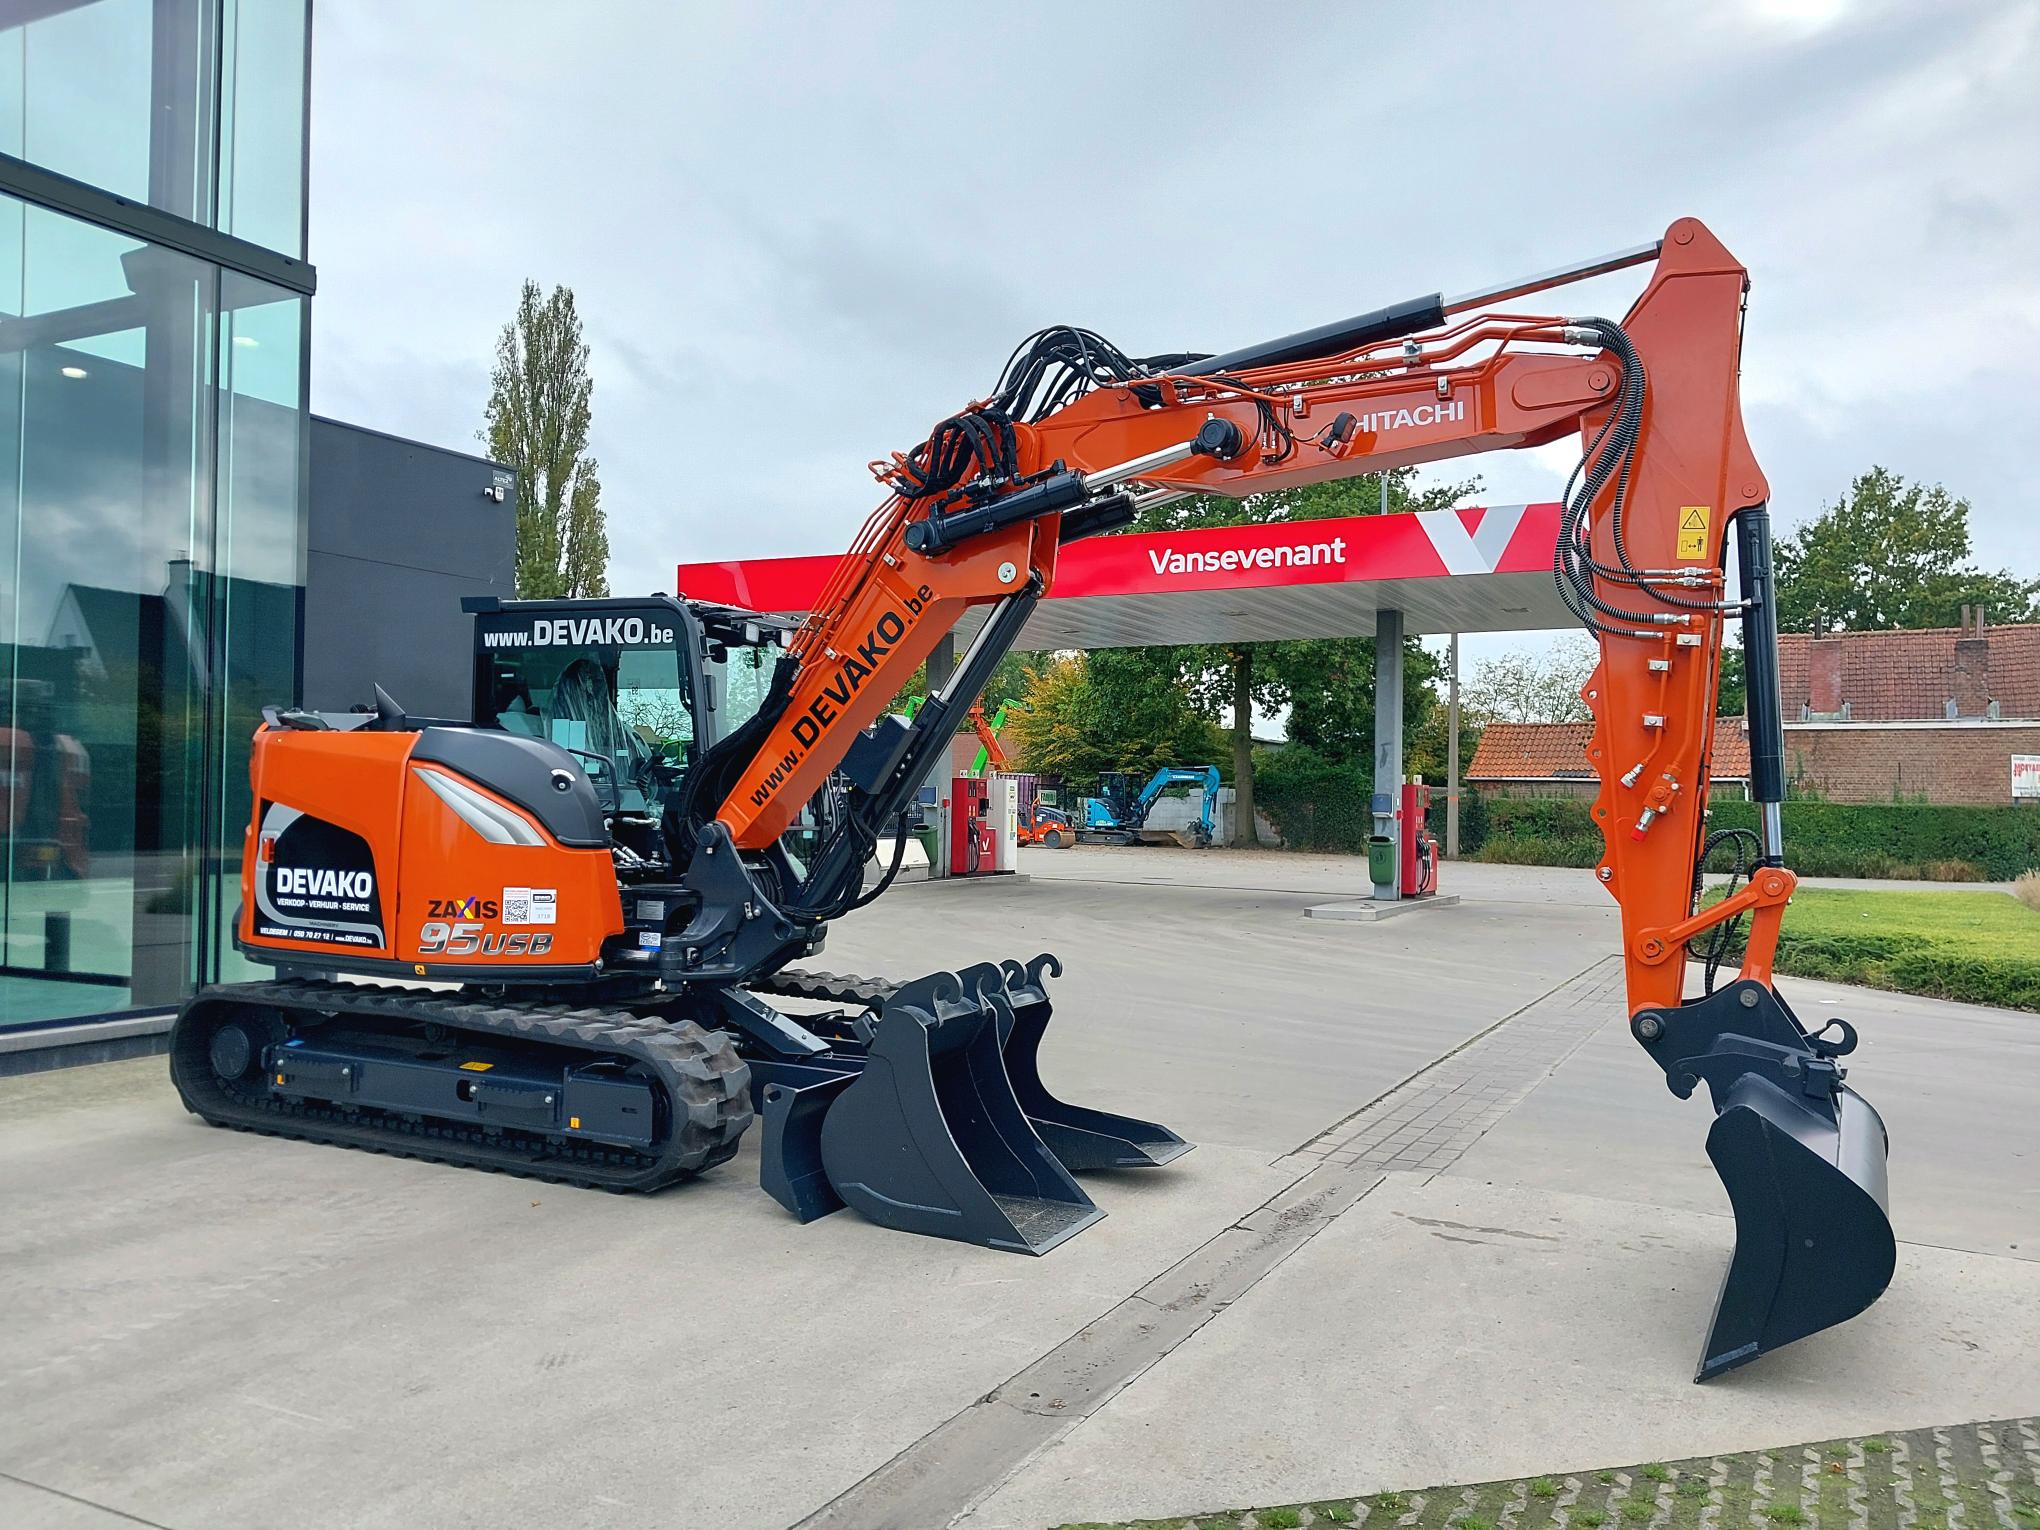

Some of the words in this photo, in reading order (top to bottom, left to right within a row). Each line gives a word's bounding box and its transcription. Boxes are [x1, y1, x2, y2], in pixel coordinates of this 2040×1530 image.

[1353, 401, 1464, 434] HITACHI
[1149, 537, 1346, 575] Vansevenant
[484, 617, 674, 647] www.DEVAKO.be
[750, 584, 934, 807] www.DEVAKO.be
[277, 868, 372, 898] DEVAKO
[276, 898, 306, 907] VERKOOP
[309, 900, 338, 910] VERHUUR
[342, 902, 370, 912] SERVICE
[428, 896, 498, 920] ZAXIS
